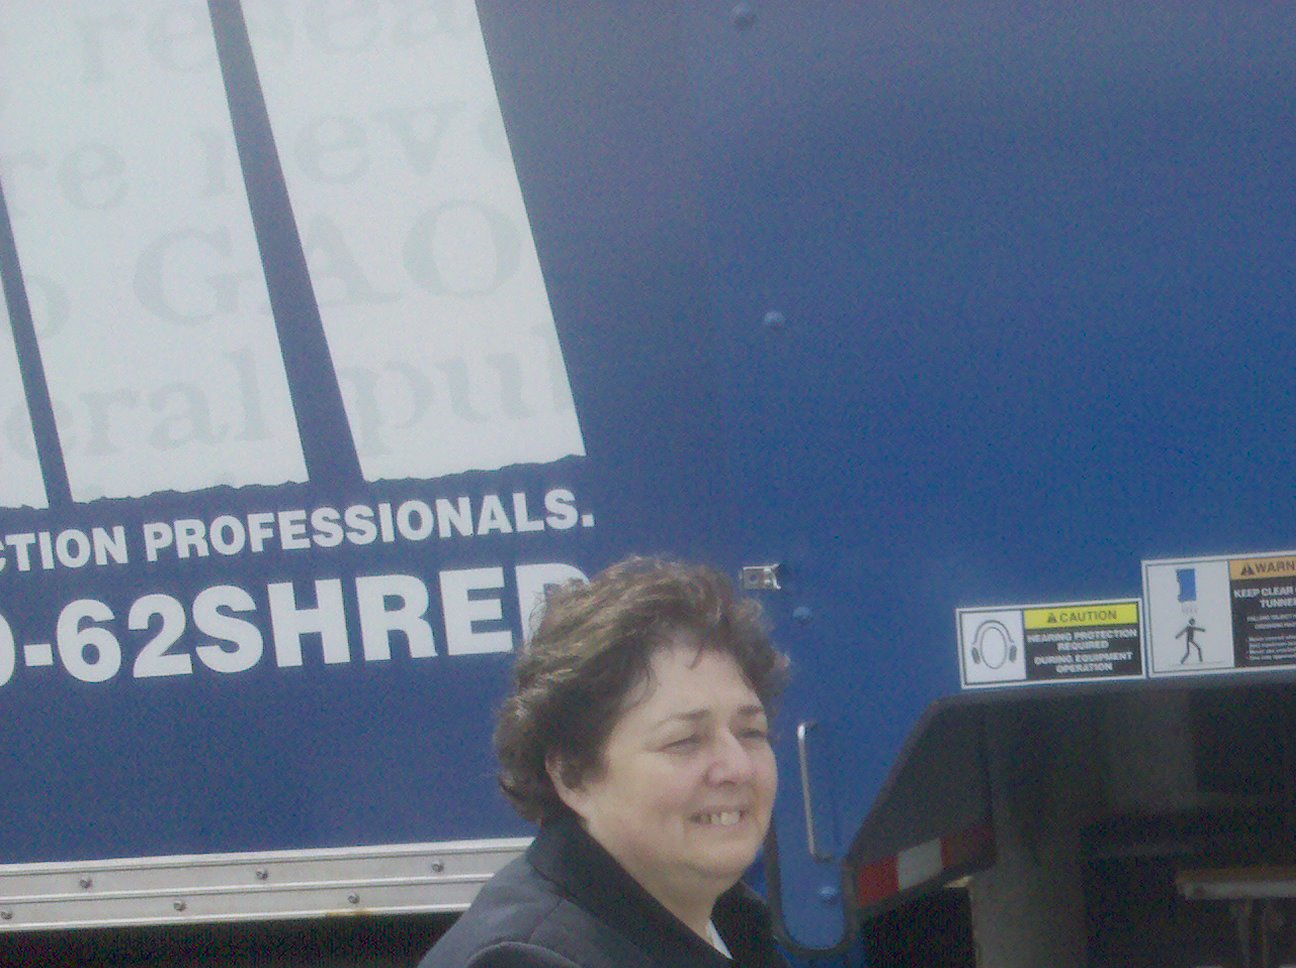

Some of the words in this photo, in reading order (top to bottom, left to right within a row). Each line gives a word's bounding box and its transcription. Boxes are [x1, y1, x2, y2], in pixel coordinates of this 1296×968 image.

[0, 525, 129, 573] TION
[143, 488, 596, 563] PROFESSIONALS.
[1233, 587, 1260, 599] KEEP
[1261, 585, 1294, 597] CLEAR
[1059, 609, 1118, 623] CAUTION
[1073, 628, 1138, 641] PROTECTION
[1056, 640, 1110, 652] REQUIRED
[1033, 654, 1073, 666] DURING
[1074, 651, 1134, 663] EQUIPMENT
[1055, 661, 1113, 674] OPERATION
